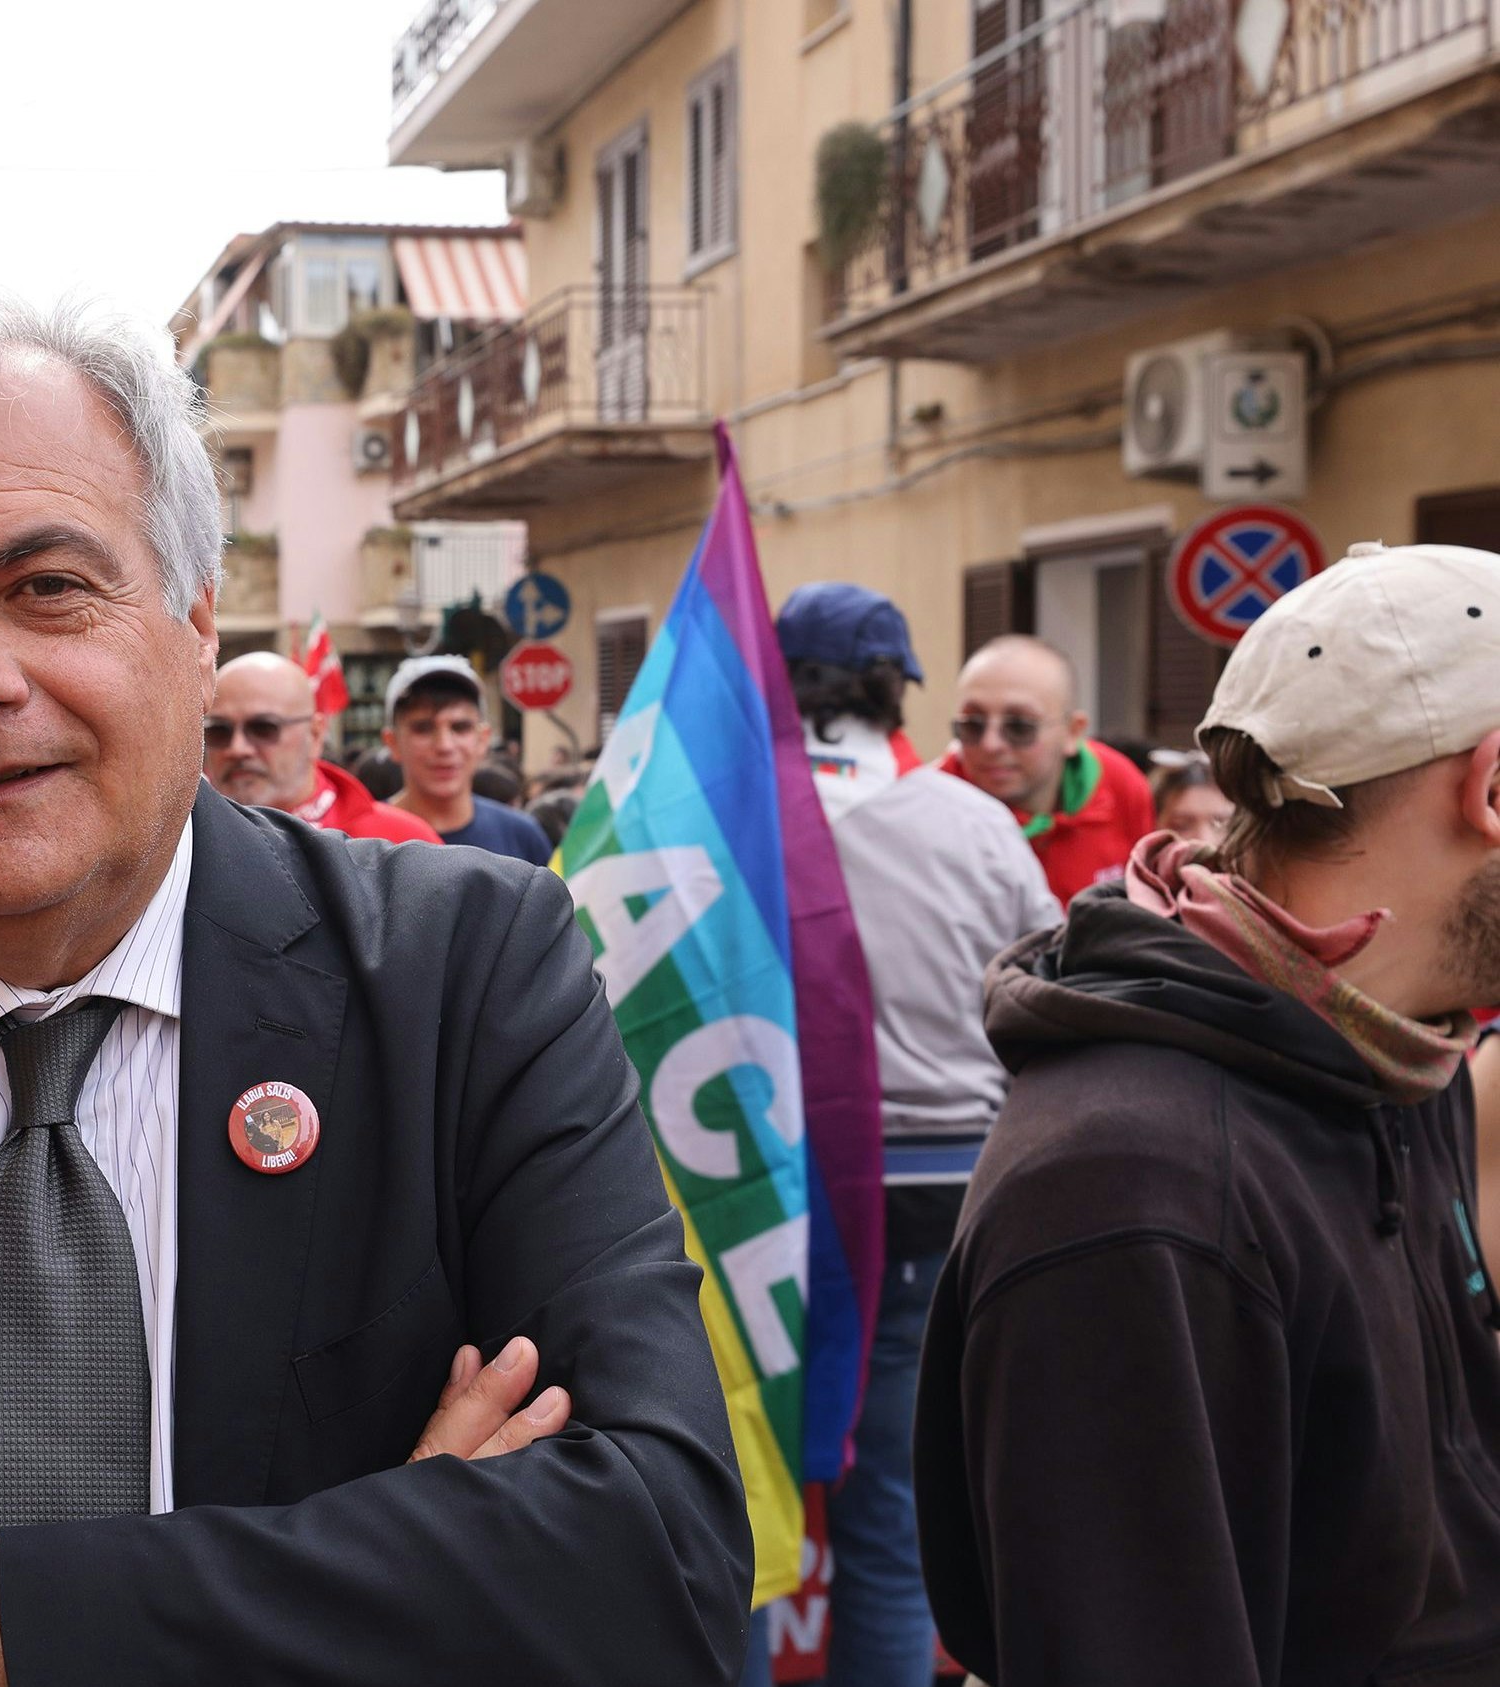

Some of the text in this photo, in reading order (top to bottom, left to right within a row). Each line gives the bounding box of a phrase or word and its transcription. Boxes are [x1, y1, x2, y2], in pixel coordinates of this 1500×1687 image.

[507, 663, 568, 693] STOP
[237, 1085, 293, 1110] ILARIA SALIS
[262, 1150, 297, 1167] LIBERA!
